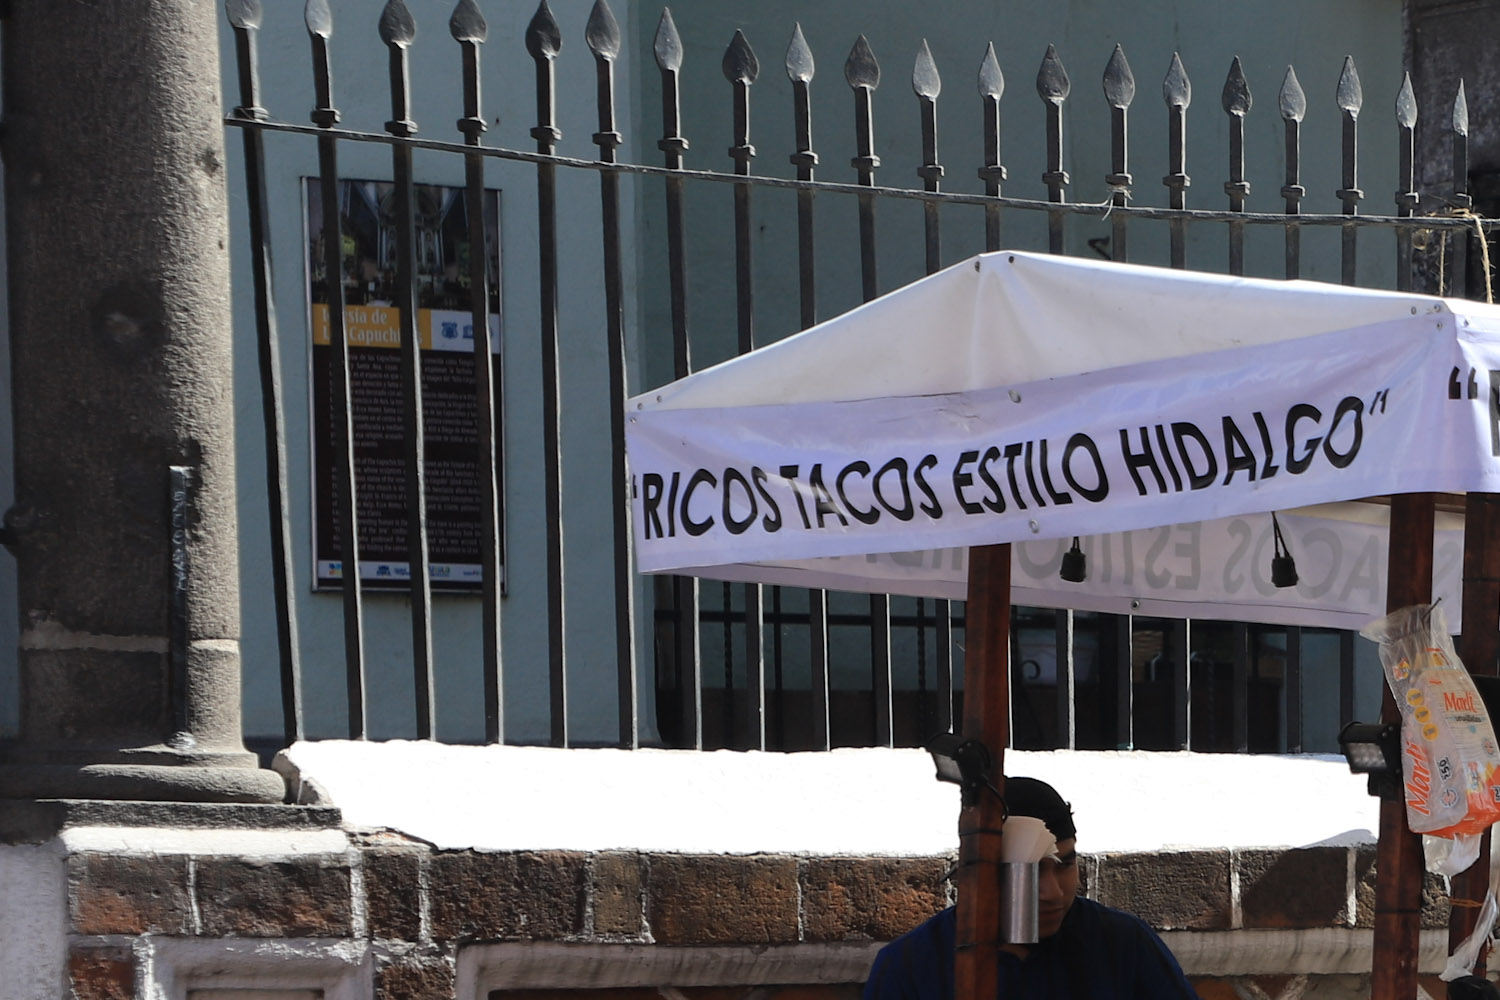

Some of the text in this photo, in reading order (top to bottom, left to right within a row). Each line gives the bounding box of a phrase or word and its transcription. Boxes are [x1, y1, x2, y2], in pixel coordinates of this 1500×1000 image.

[371, 308, 388, 325] de
[779, 454, 943, 531] TACOS
[953, 433, 1110, 515] ESTILO
[1443, 691, 1478, 713] Marli
[1407, 741, 1431, 816] Marli
